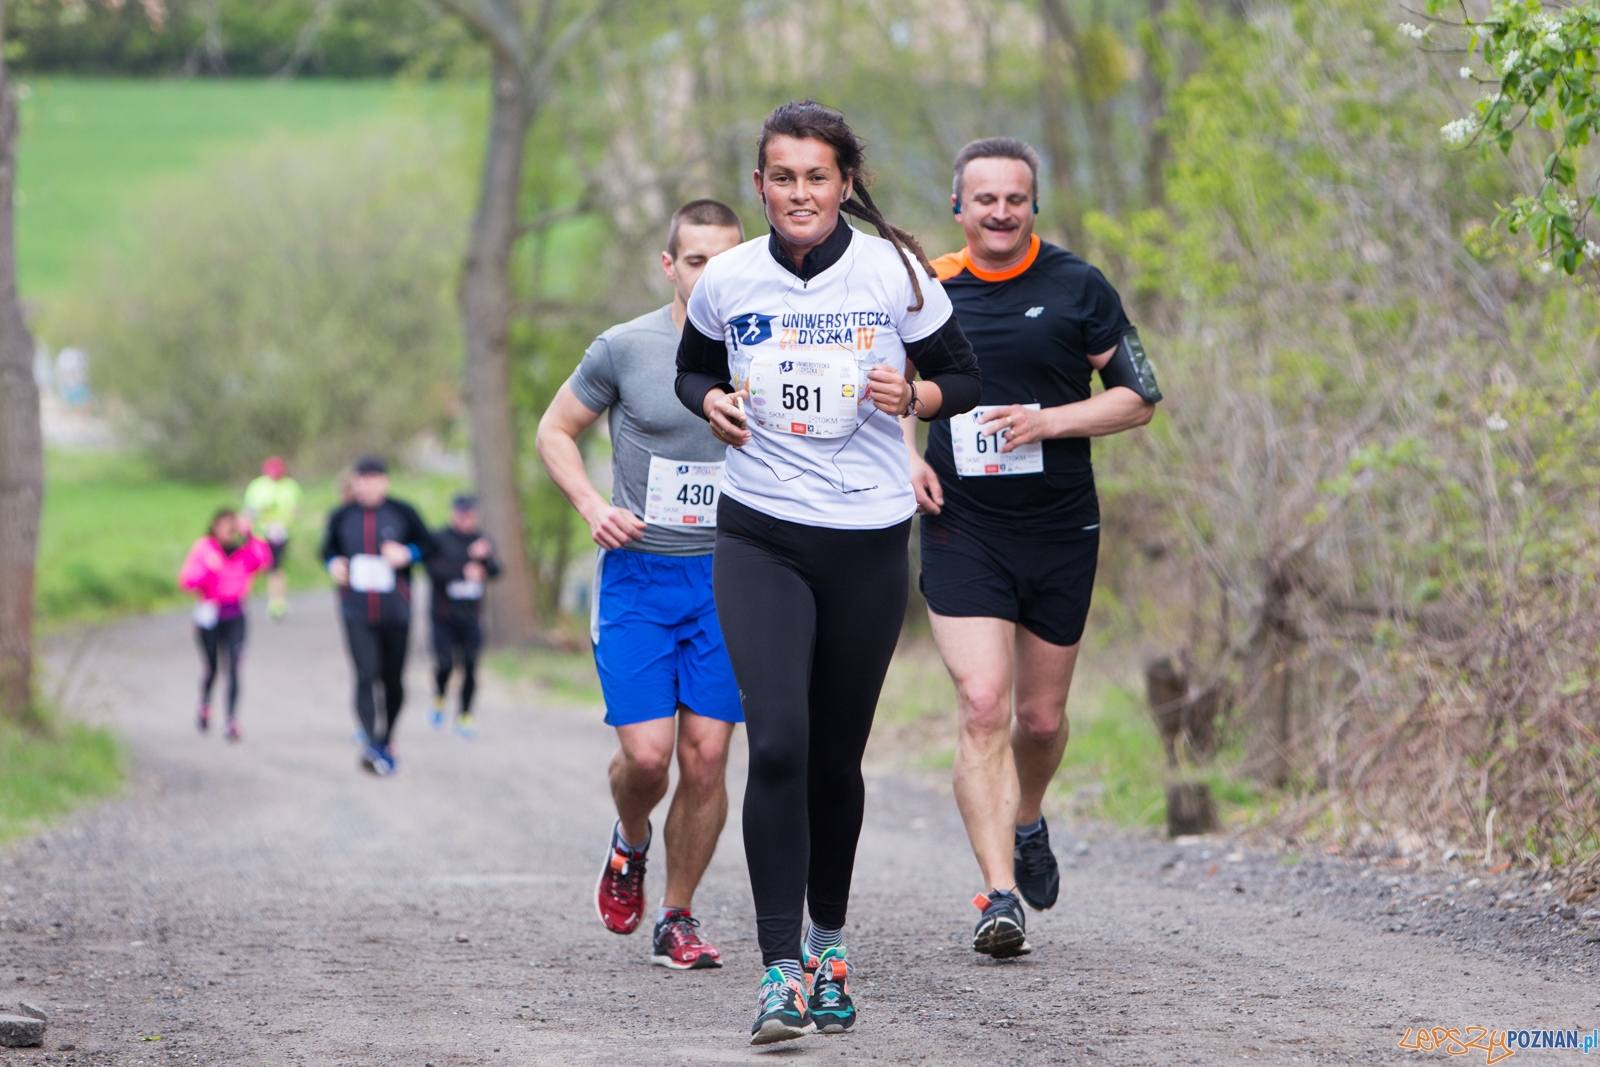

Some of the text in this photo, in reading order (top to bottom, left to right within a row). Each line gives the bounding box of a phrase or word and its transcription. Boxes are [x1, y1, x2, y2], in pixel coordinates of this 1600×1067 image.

[782, 312, 891, 328] UNIWERSYTECKA
[779, 327, 875, 350] ZADYSZKA IV
[782, 383, 821, 413] 581
[817, 416, 838, 424] 10KM
[676, 484, 714, 505] 430
